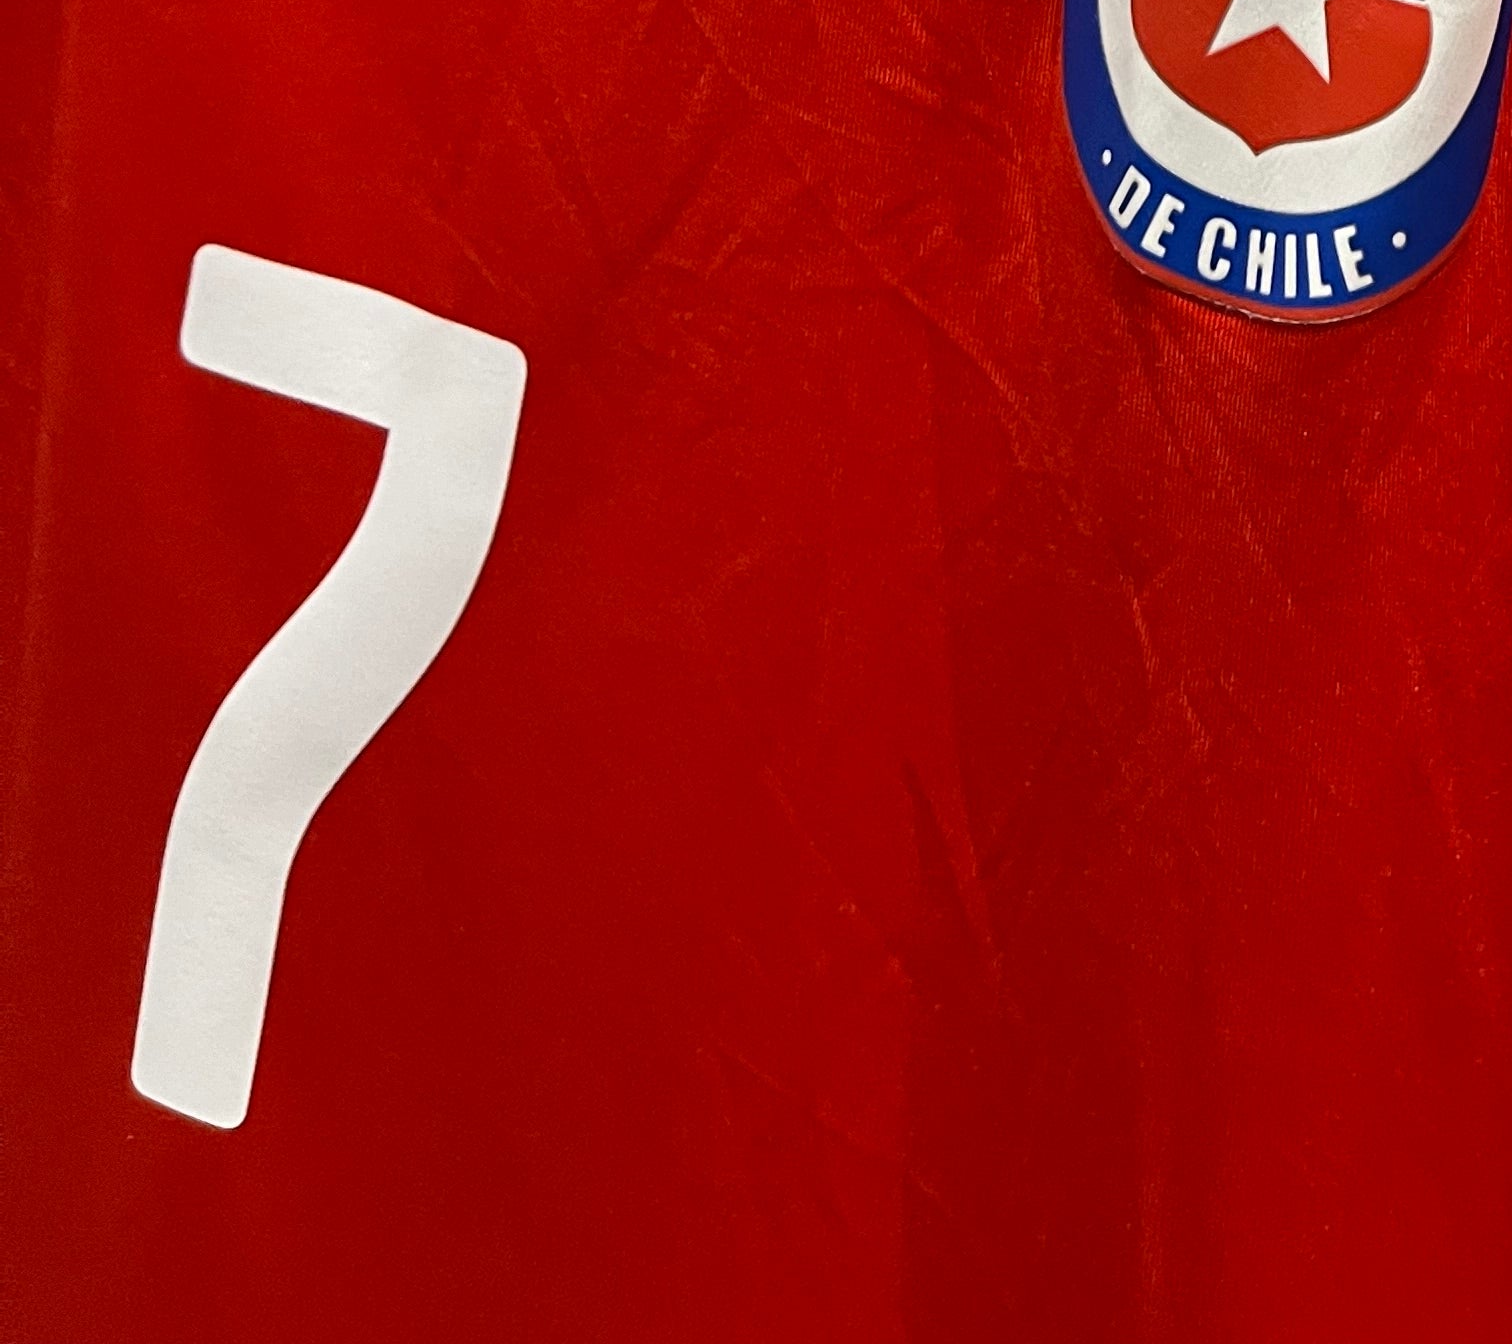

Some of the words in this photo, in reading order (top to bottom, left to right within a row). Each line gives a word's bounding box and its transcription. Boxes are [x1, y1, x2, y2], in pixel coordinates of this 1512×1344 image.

[1108, 164, 1186, 258] DE
[1196, 216, 1374, 300] CHILE
[130, 241, 529, 1131] 7
